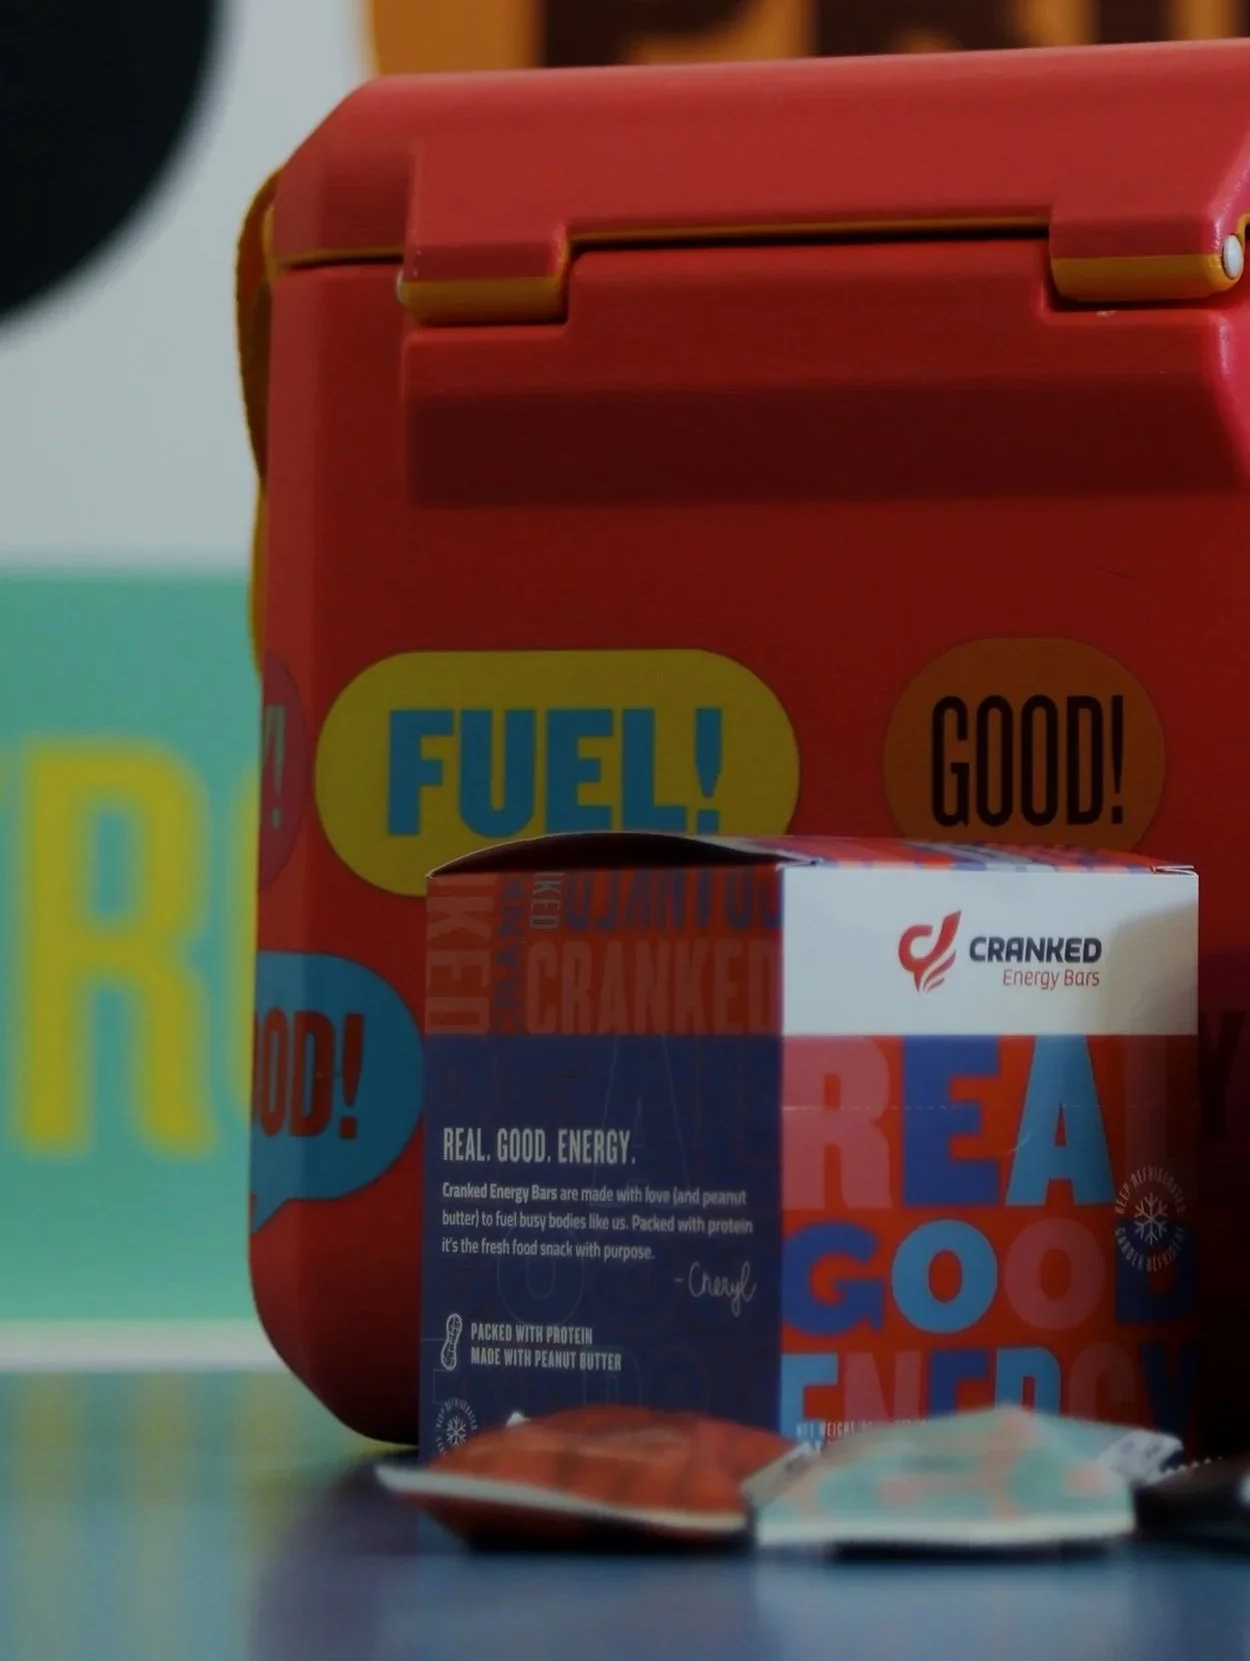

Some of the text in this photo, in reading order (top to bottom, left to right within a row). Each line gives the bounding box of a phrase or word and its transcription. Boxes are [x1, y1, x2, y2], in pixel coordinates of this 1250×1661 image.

[387, 706, 723, 838] FUEL!
[932, 695, 1124, 828] GOOD!
[970, 937, 1102, 964] CRANKED
[526, 939, 779, 1034] CRANKED
[1003, 969, 1100, 991] Energy Bars
[253, 1007, 364, 1140] OD!
[782, 1035, 1198, 1209] REAL
[443, 1127, 635, 1165] REAL. GOOD. ENERGY.
[442, 1182, 747, 1210] Cranked Energy Bars are made with love (and peanut
[442, 1209, 753, 1237] butter) to fuel busy bodies like us. Packed with protein
[461, 1237, 478, 1254] the
[481, 1238, 510, 1255] fresh
[512, 1238, 538, 1256] food
[540, 1239, 573, 1257] snack
[576, 1240, 601, 1258] with
[604, 1244, 655, 1263] purpose.
[783, 1218, 1198, 1336] GOOD
[471, 1322, 593, 1345] PACKED WITH PROTEIN
[471, 1347, 622, 1372] MADE WITH PEANUT BUTTER
